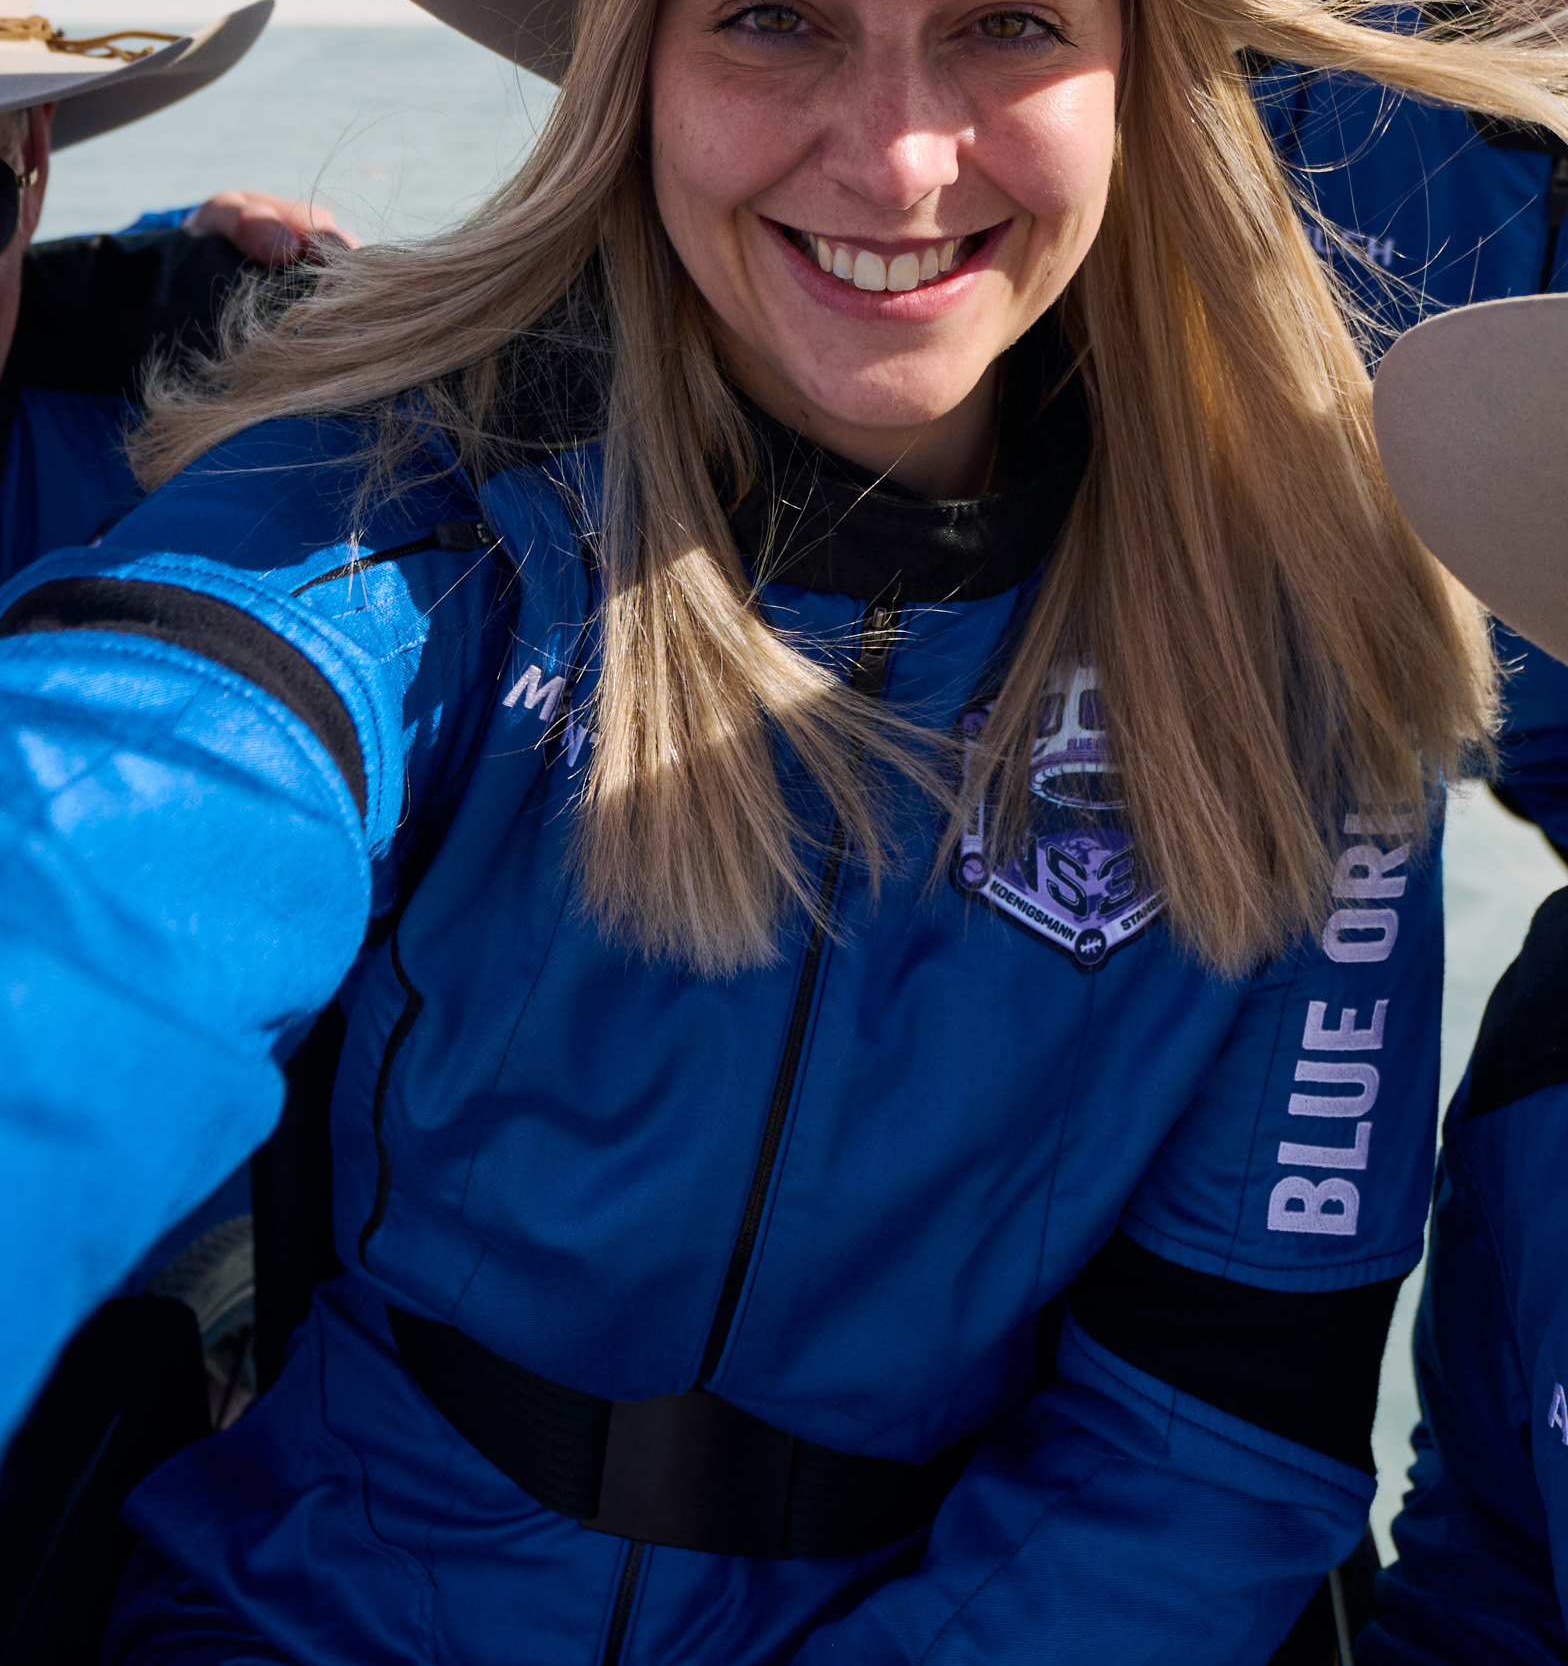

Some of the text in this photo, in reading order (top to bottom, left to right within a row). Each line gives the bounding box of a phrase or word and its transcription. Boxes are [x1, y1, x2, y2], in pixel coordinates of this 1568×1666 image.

[989, 879, 1077, 943] KOENIGSMANN
[1266, 808, 1415, 1237] BLUE ORI
